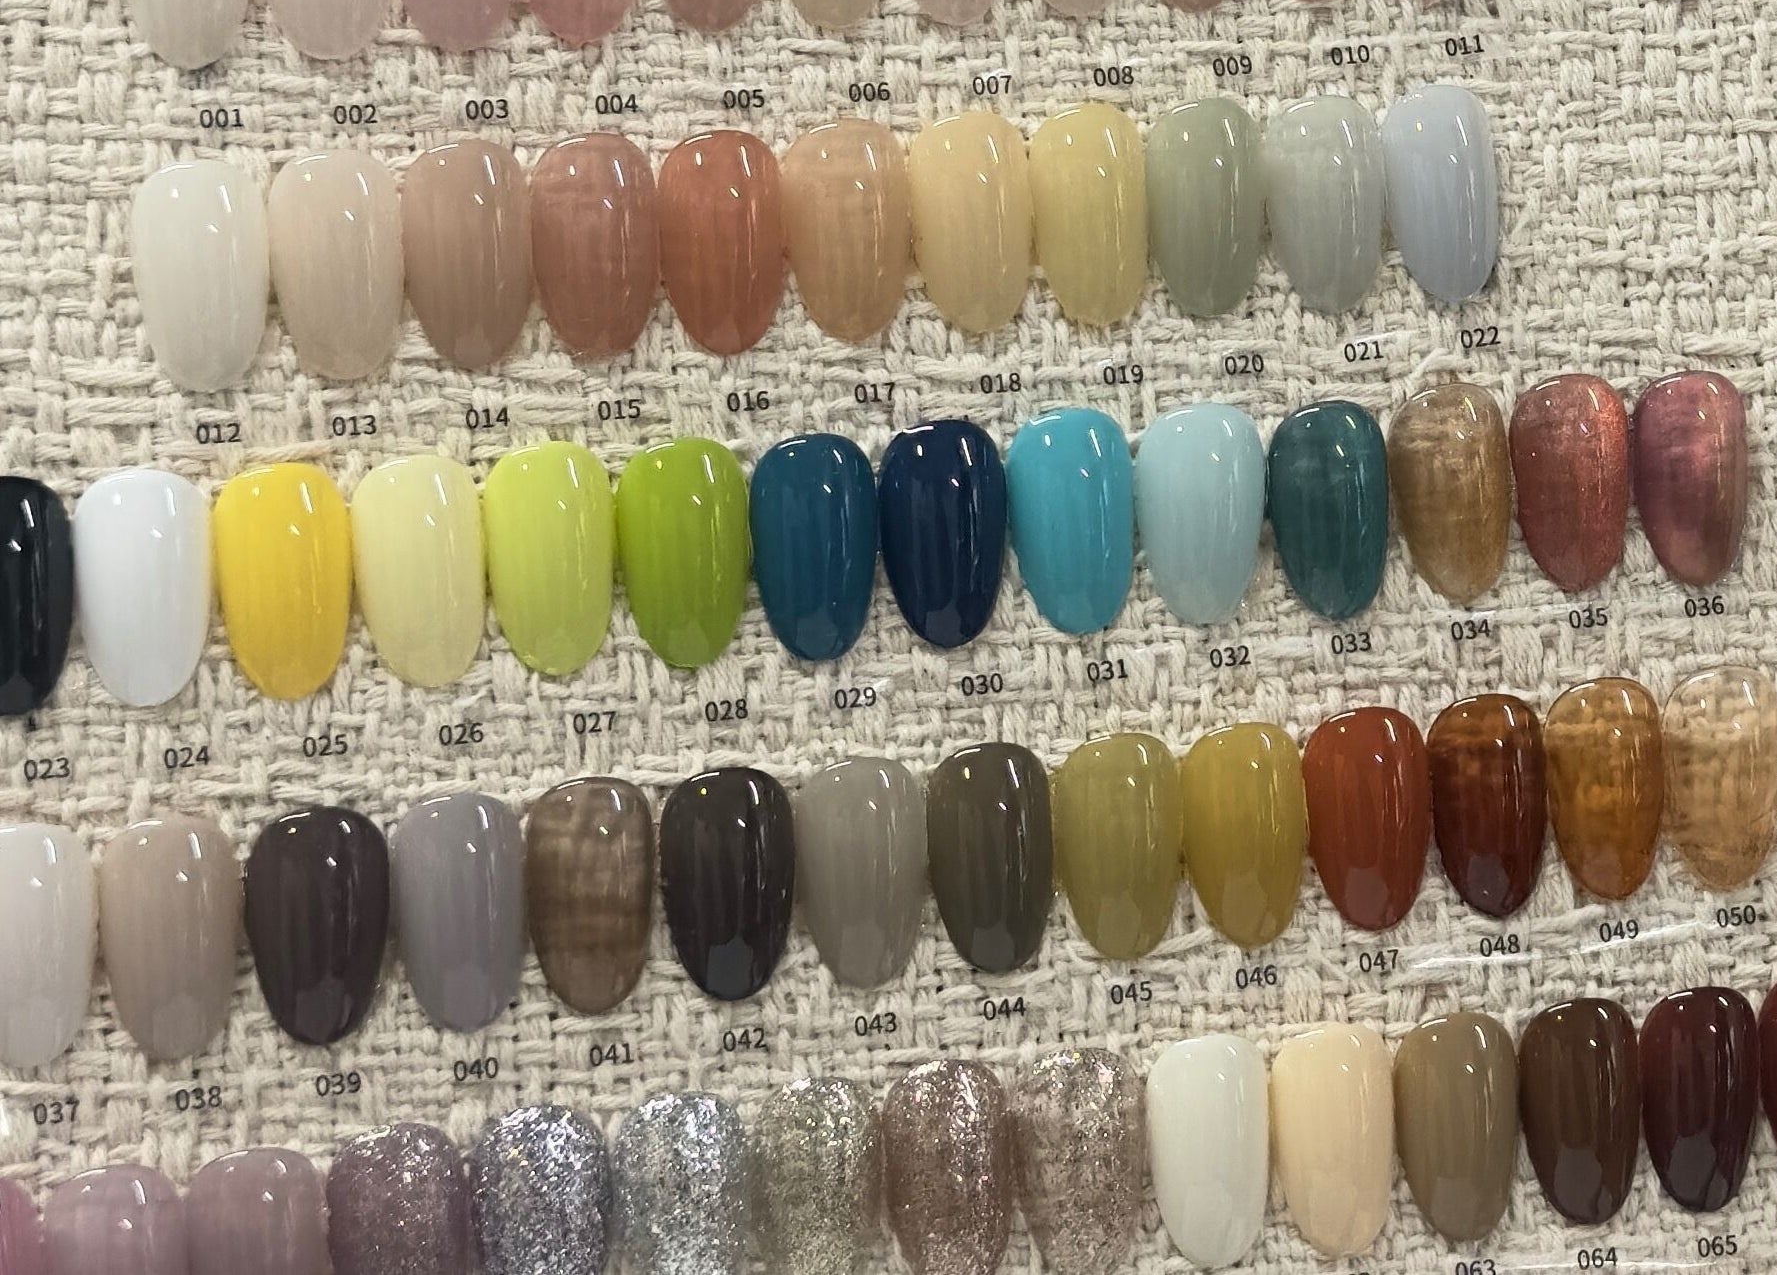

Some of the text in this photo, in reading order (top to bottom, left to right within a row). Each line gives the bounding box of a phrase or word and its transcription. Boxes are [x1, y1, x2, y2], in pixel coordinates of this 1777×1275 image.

[1329, 44, 1371, 67] 010
[1444, 34, 1486, 58] 011
[1092, 65, 1135, 88] 008
[1211, 55, 1253, 78] 009
[847, 81, 891, 104] 006
[972, 74, 1014, 97] 007
[464, 98, 510, 121] 003
[594, 93, 640, 116] 004
[722, 89, 766, 111] 005
[199, 107, 244, 131] 001
[332, 103, 379, 126] 002
[1459, 326, 1501, 349] 022
[1343, 340, 1384, 363] 021
[1102, 364, 1144, 386] 019
[1223, 354, 1265, 377] 020
[854, 381, 897, 405] 017
[979, 372, 1022, 394] 018
[597, 398, 642, 421] 015
[726, 390, 771, 413] 016
[331, 415, 377, 437] 013
[464, 406, 511, 430] 014
[195, 422, 243, 446] 012
[1568, 606, 1609, 630] 035
[1683, 595, 1725, 618] 036
[1450, 619, 1492, 642] 034
[1330, 632, 1373, 656] 033
[1208, 645, 1250, 669] 032
[1086, 659, 1129, 683] 031
[960, 673, 1004, 697] 030
[833, 687, 877, 710] 029
[572, 711, 617, 735] 027
[704, 699, 748, 723] 028
[302, 734, 349, 758] 025
[438, 723, 484, 746] 026
[24, 757, 71, 781] 023
[164, 746, 210, 770] 024
[1716, 905, 1757, 928] 050
[1598, 919, 1640, 943] 049
[1479, 934, 1521, 958] 048
[1358, 949, 1400, 973] 047
[1235, 965, 1278, 989] 046
[1109, 981, 1153, 1006] 045
[982, 996, 1027, 1021] 044
[853, 1012, 898, 1037] 043
[722, 1028, 767, 1053] 042
[589, 1044, 635, 1068] 041
[453, 1057, 500, 1082] 040
[315, 1072, 363, 1097] 039
[174, 1086, 223, 1112] 038
[33, 1100, 80, 1126] 037
[1577, 1247, 1619, 1271] 064
[1697, 1235, 1739, 1259] 065
[1454, 1258, 1497, 1275] 063
